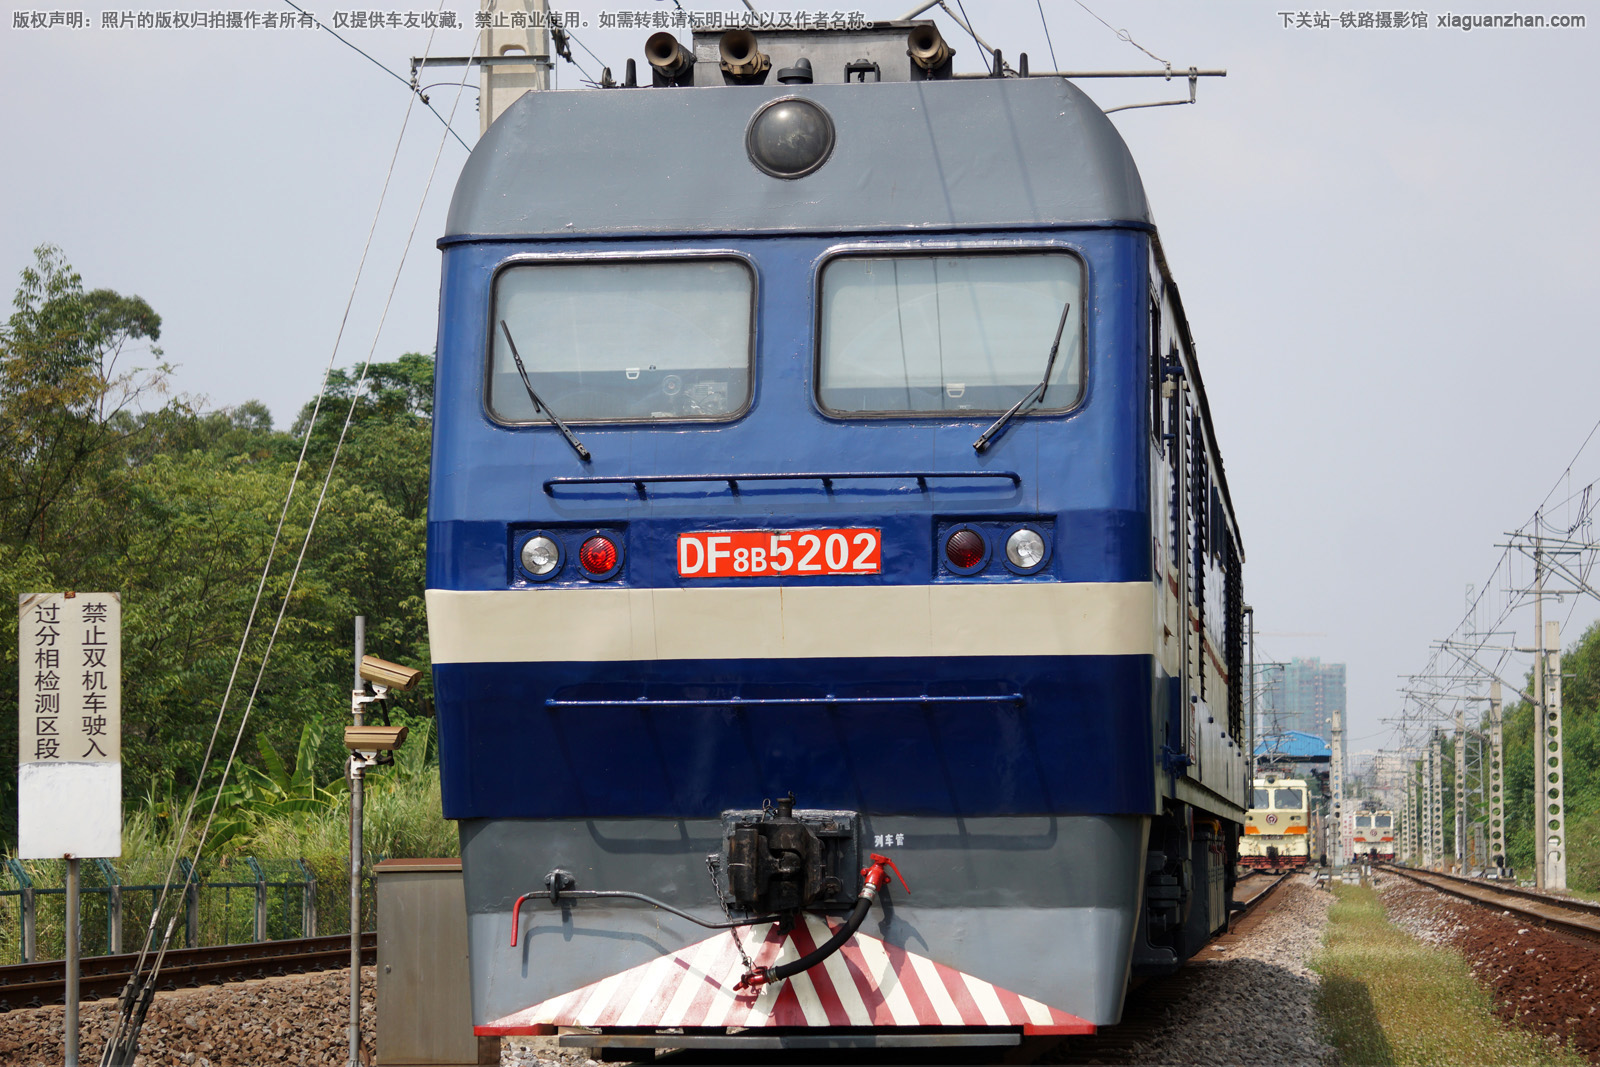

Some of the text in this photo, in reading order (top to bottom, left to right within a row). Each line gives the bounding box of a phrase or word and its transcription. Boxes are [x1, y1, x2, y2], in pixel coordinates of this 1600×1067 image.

[34, 603, 61, 760] 过分相检测区段
[81, 602, 108, 759] 禁止双机车驶入
[874, 833, 904, 848] 列车管
